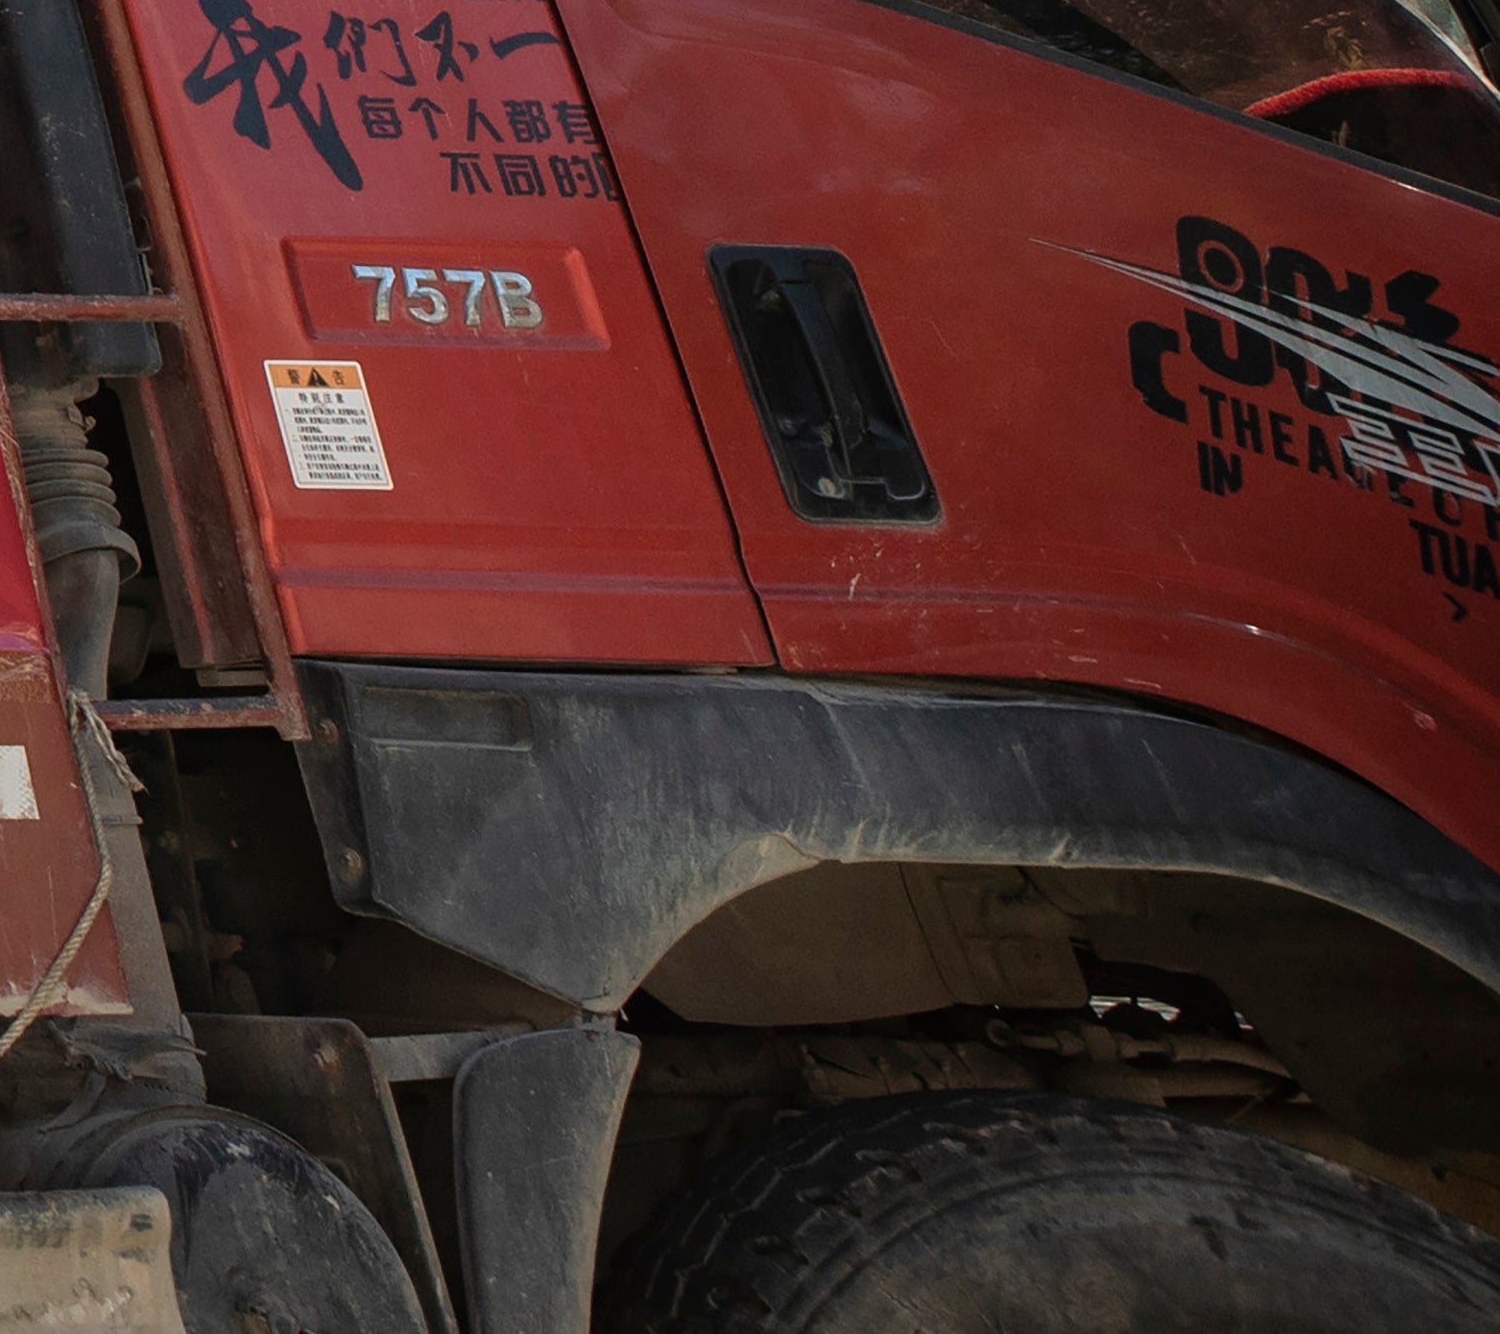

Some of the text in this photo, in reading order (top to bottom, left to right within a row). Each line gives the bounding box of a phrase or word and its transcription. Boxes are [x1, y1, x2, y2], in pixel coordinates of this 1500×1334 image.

[358, 95, 598, 144] 每个人都有
[352, 264, 543, 328] 757B
[1196, 441, 1243, 497] IN
